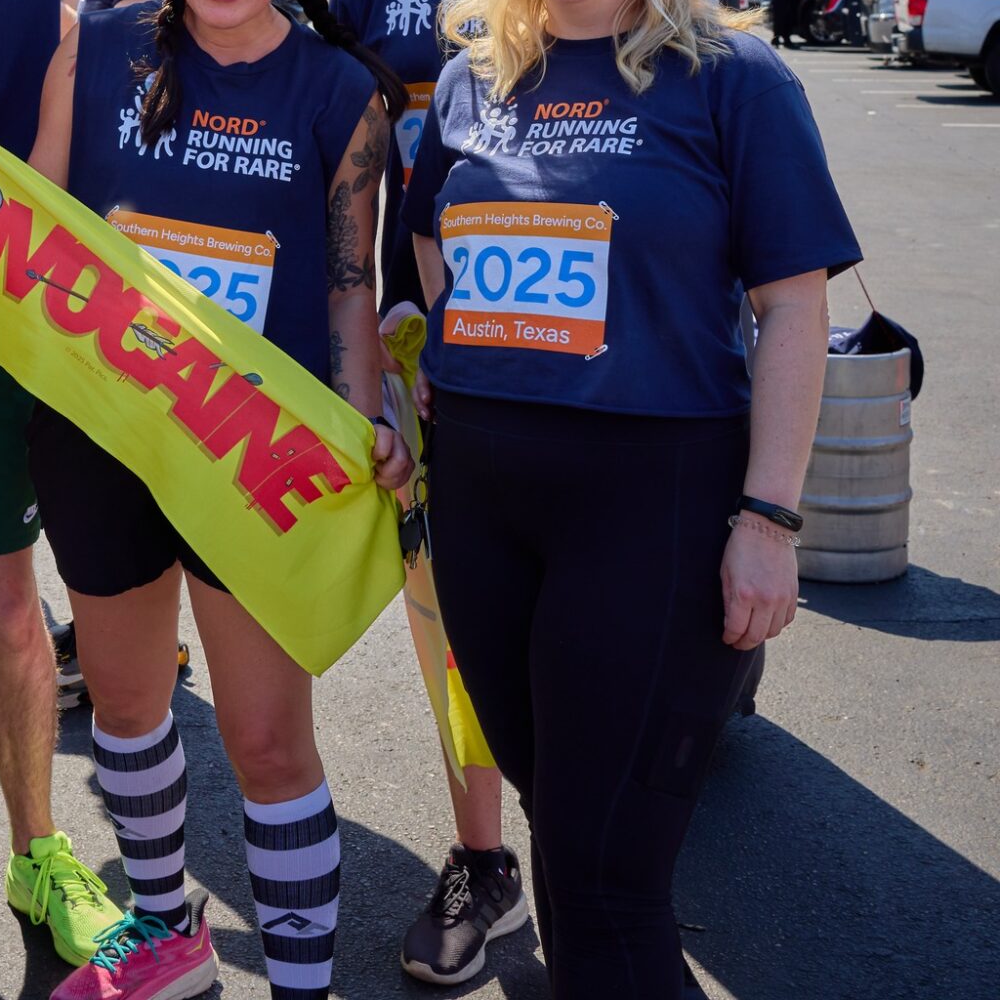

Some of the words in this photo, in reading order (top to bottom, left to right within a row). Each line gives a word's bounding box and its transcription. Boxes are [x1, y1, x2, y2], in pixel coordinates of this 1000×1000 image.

[525, 117, 638, 139] RUNNING
[187, 129, 293, 160] RUNNING
[517, 140, 567, 157] FOR
[182, 148, 230, 172] FOR
[443, 215, 482, 229] Southern
[485, 214, 530, 228] Heights
[532, 215, 582, 231] Brewing
[585, 217, 608, 230] Co.
[161, 229, 204, 246] Heights
[206, 238, 253, 256] Brewing
[254, 245, 272, 257] Co.
[158, 259, 260, 322] 25
[451, 246, 596, 308] 2025
[452, 317, 508, 341] Austin,
[514, 320, 571, 344] Texas
